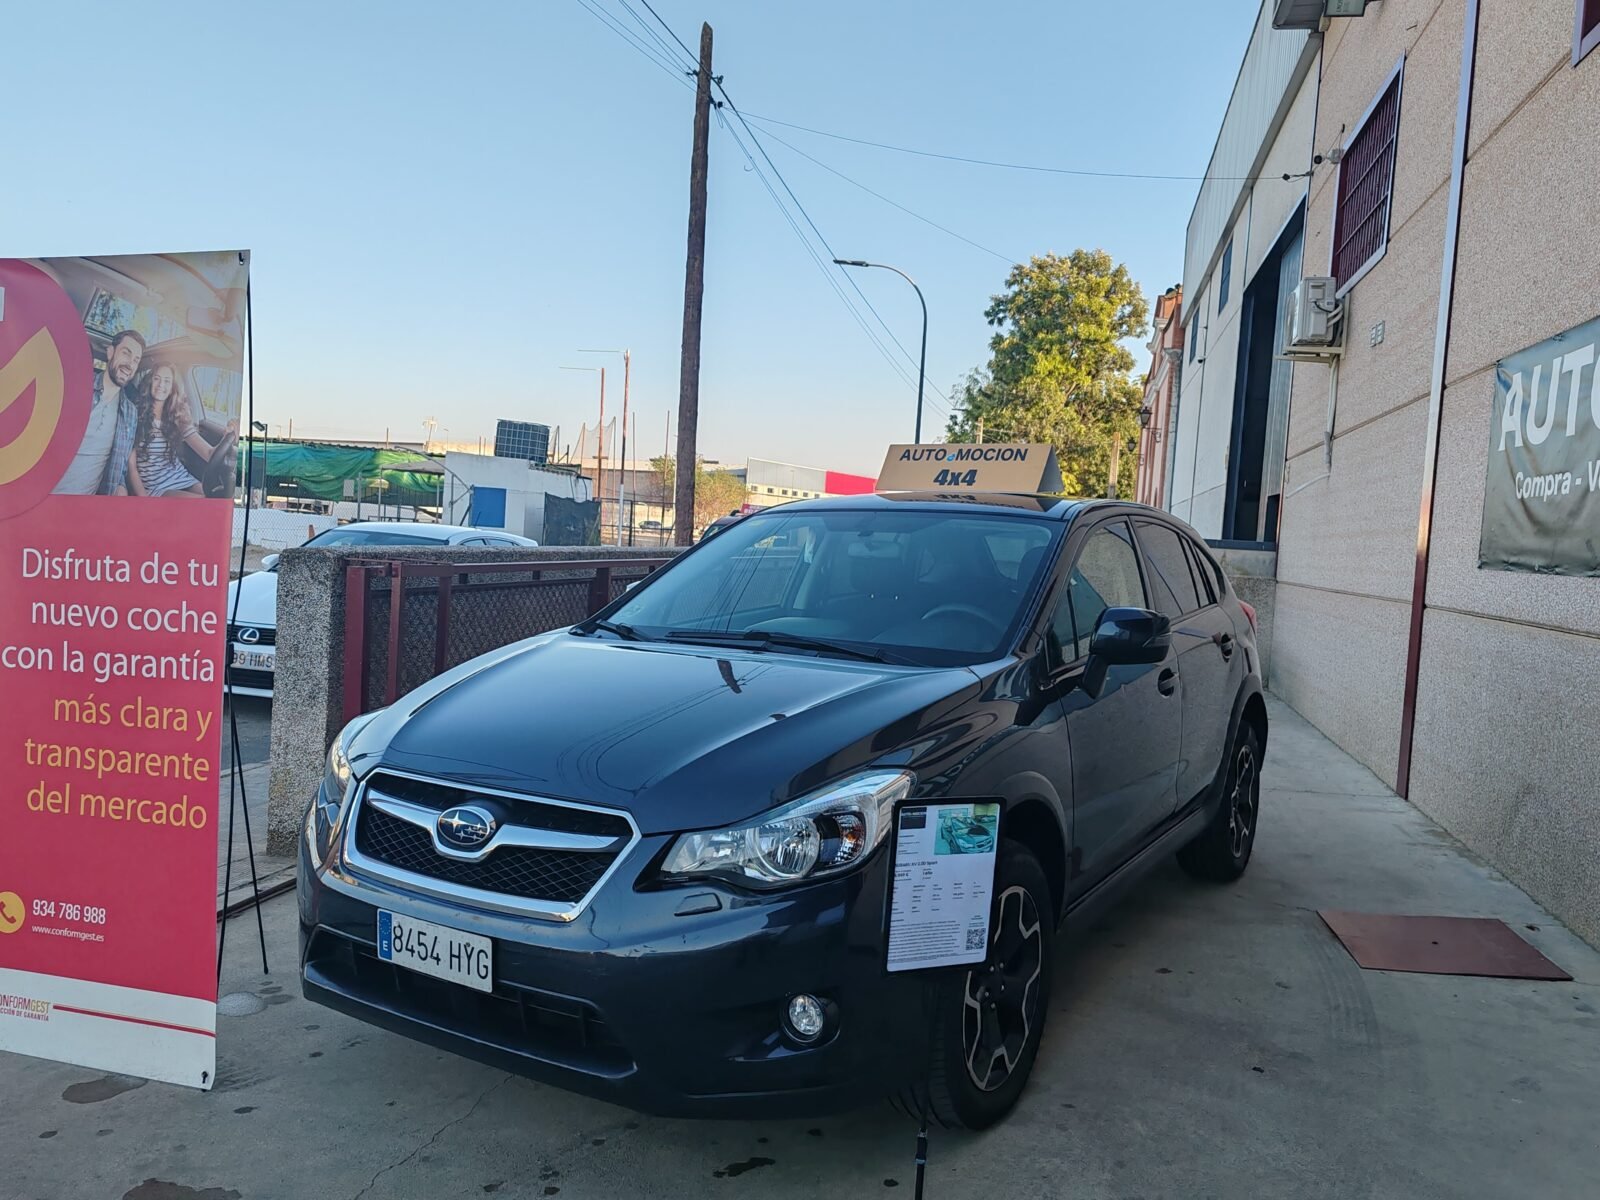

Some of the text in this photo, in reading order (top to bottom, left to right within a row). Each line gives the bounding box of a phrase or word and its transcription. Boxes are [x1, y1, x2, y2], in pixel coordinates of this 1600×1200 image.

[1499, 343, 1600, 451] AUT
[900, 448, 1028, 461] AUTO MOCION
[933, 469, 977, 486] 4x4
[1515, 471, 1572, 501] Compra
[22, 548, 219, 586] Disfruta de tu
[32, 600, 217, 634] nuevo coche
[1, 640, 215, 683] con la garantía
[54, 693, 212, 742] más clara y
[25, 738, 210, 781] transparente
[27, 780, 207, 829] del mercado
[33, 899, 106, 925] 934 786 988
[32, 925, 104, 942] www.conformgest.es
[382, 940, 388, 951] E
[393, 923, 488, 980] 8454 HYG
